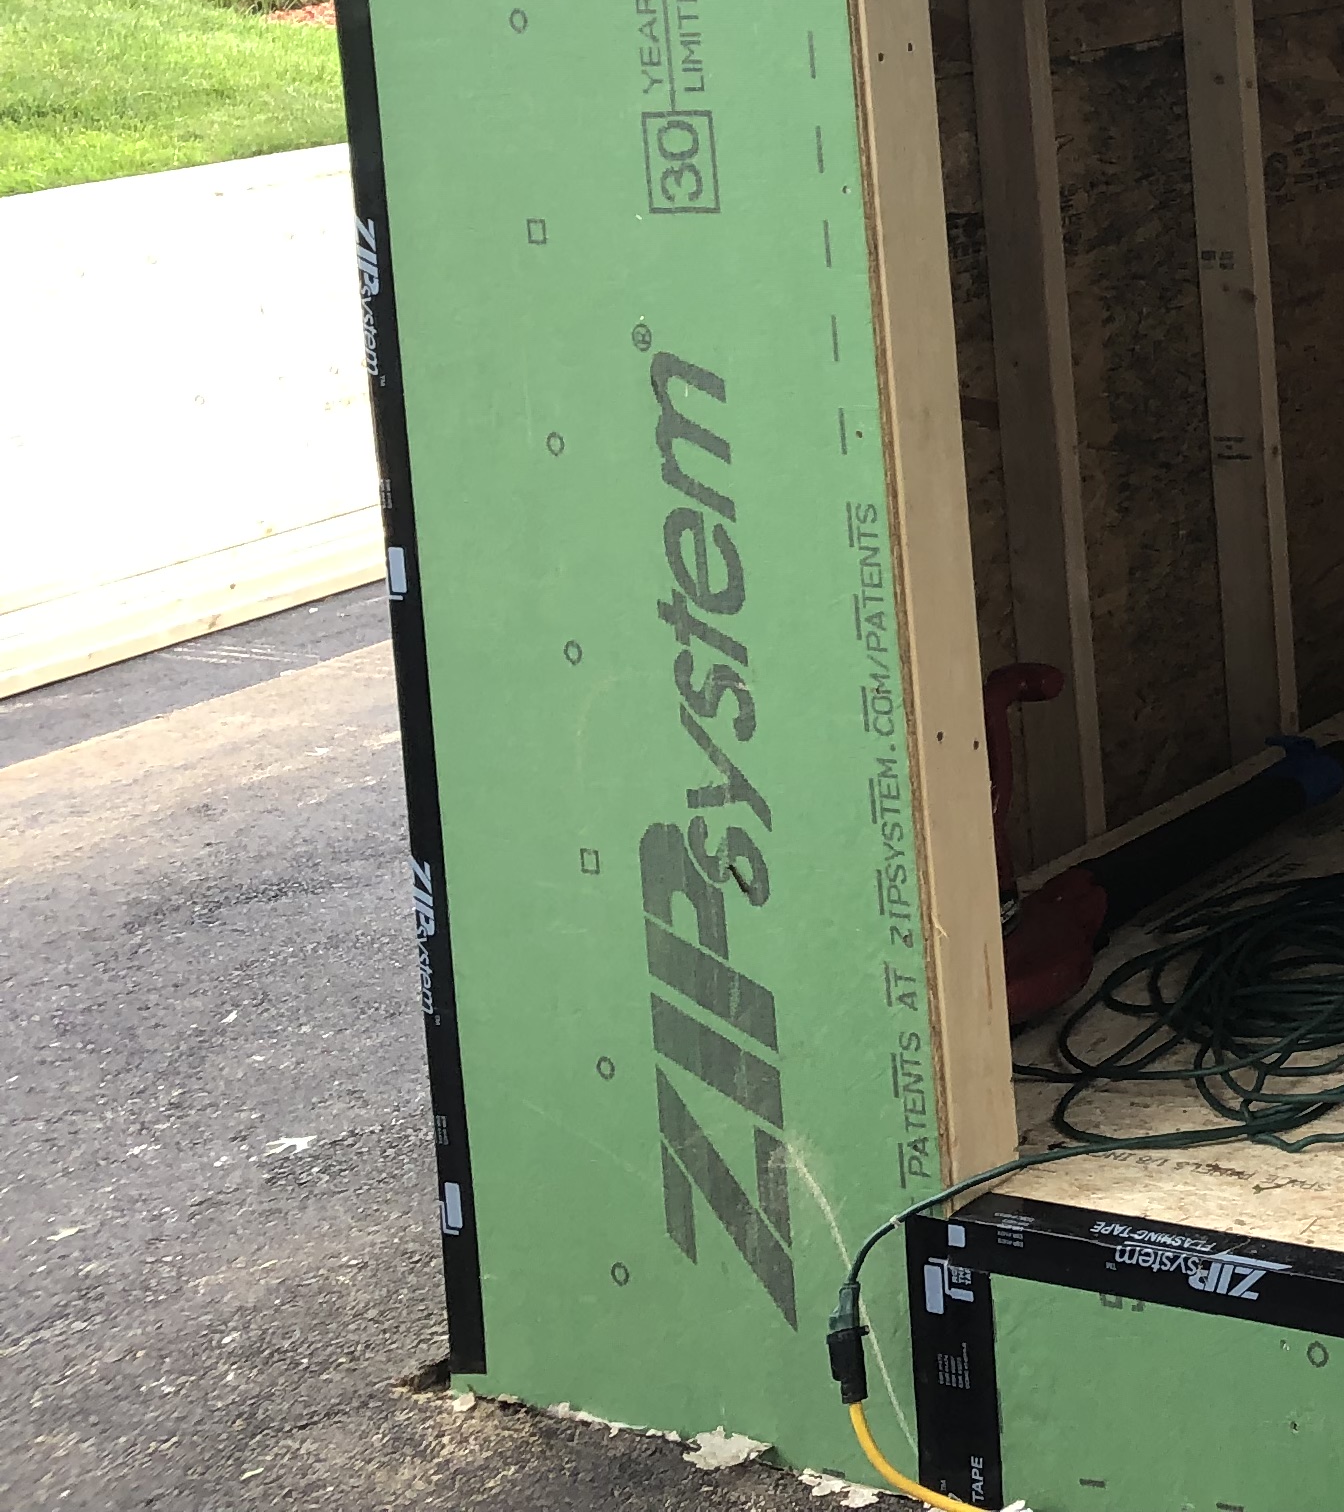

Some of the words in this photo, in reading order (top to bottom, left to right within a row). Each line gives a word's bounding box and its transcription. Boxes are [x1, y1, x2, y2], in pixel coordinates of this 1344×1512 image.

[657, 118, 705, 202] 30
[893, 964, 919, 1012] AT
[898, 1032, 933, 1179] PATENTS
[970, 1455, 985, 1503] TAPE
